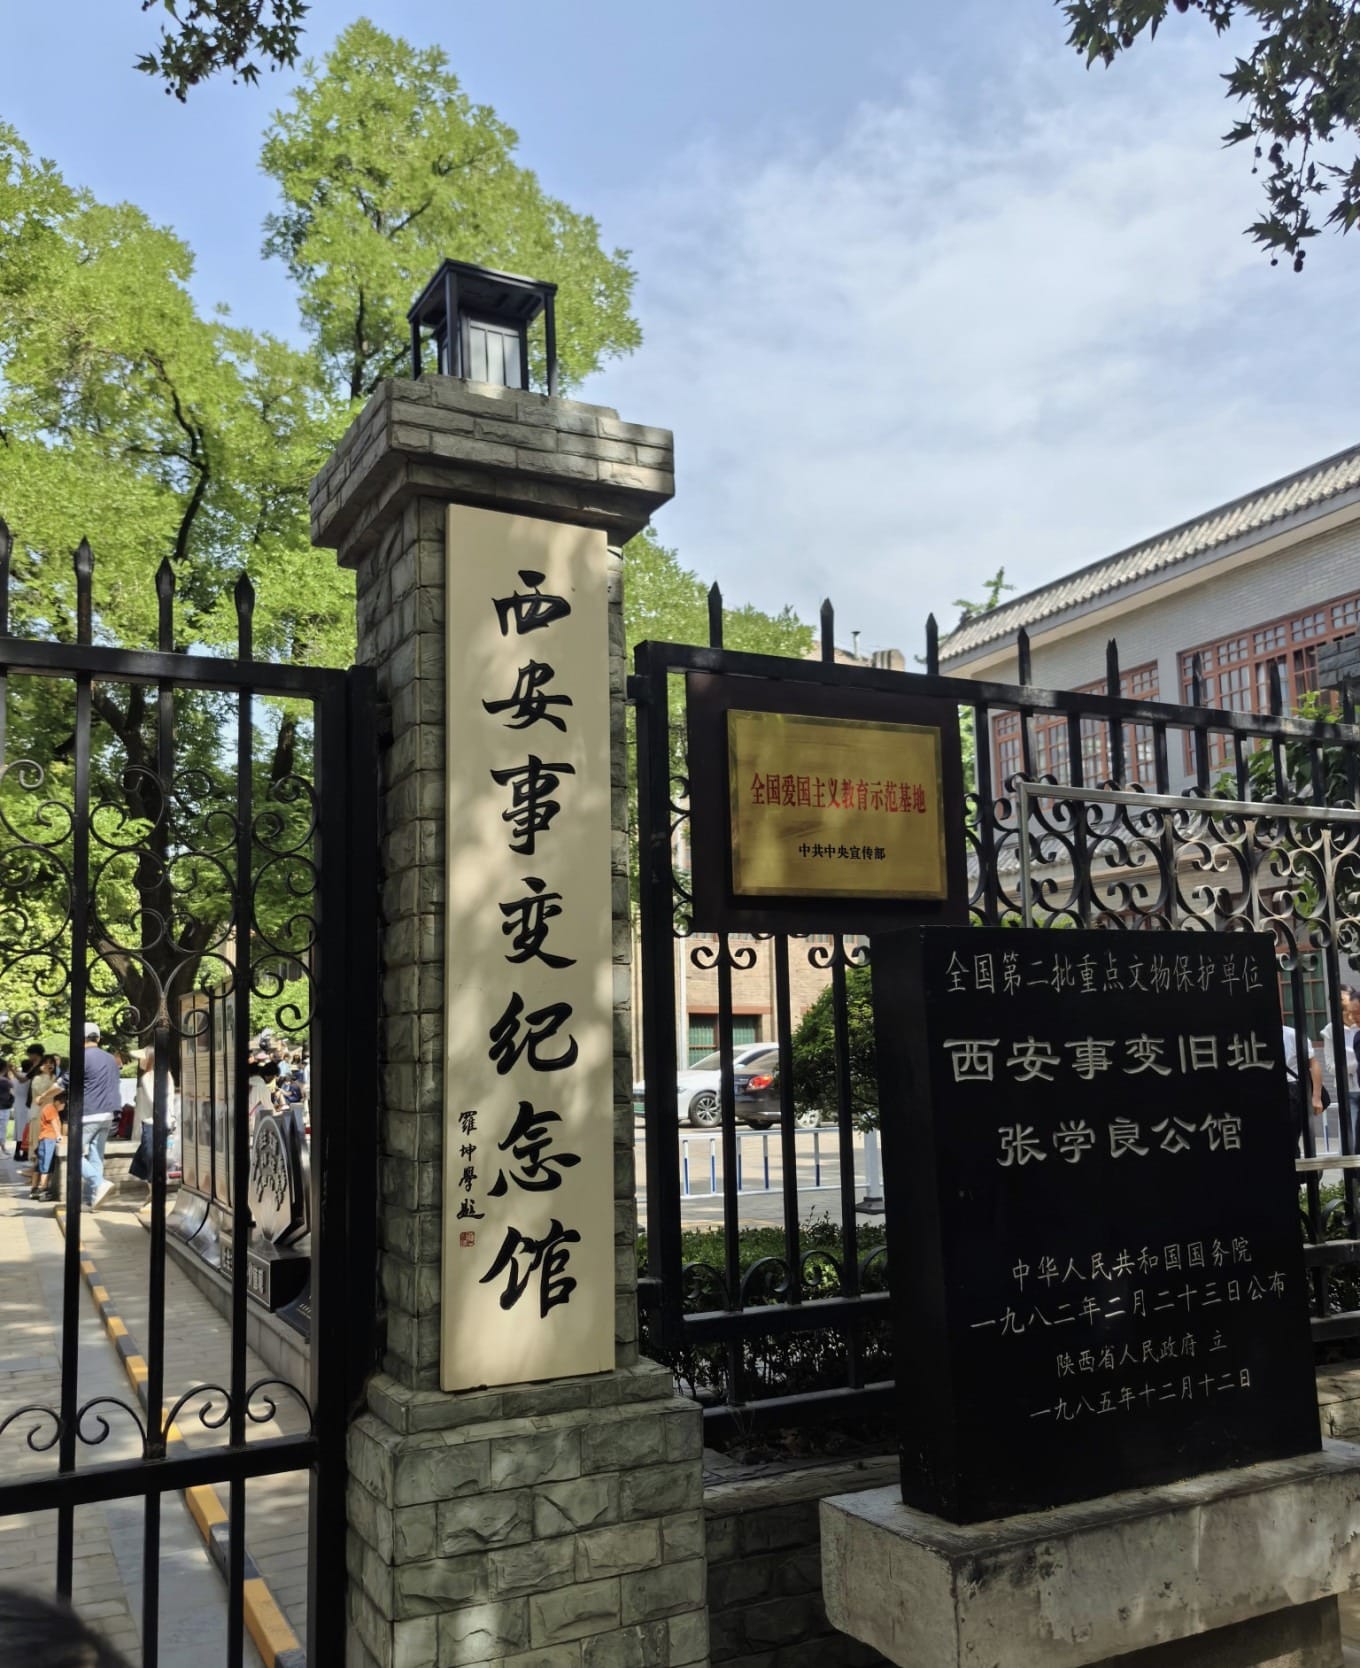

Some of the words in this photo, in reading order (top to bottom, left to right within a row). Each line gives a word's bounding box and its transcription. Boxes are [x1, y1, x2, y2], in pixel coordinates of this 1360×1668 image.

[751, 773, 926, 814] 全国爱国主义教育示范基地
[798, 842, 886, 861] 中共中央宣传部
[479, 569, 582, 1319] 西安事变纪念馆
[945, 950, 1264, 996] 全国第二批重点文物保护单位
[943, 1030, 1275, 1083] 西安事变旧址
[997, 1112, 1242, 1167] 张学良公馆
[1012, 1237, 1253, 1292] 中华人民共和国国务院
[969, 1271, 1287, 1336] 一九八二年二月二十三日公布
[1030, 1368, 1251, 1421] 一九八五年十二月十二日
